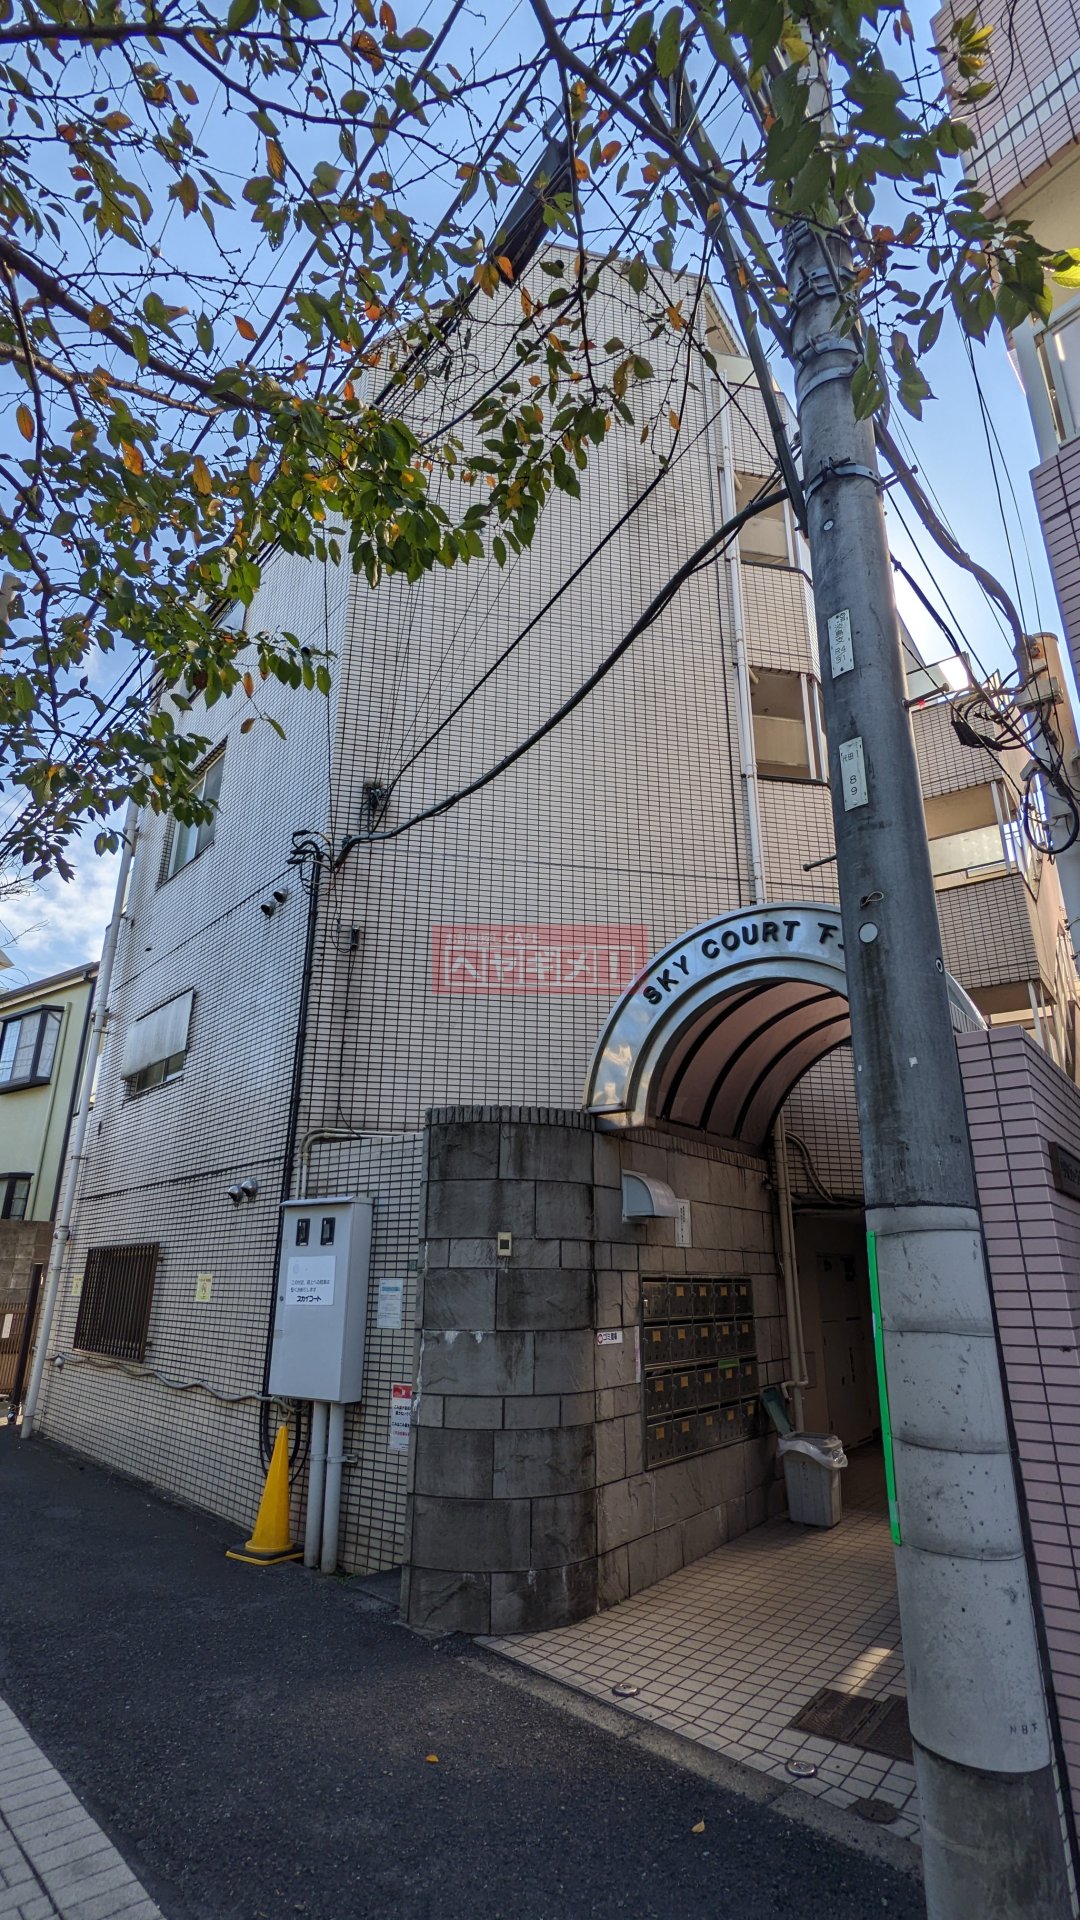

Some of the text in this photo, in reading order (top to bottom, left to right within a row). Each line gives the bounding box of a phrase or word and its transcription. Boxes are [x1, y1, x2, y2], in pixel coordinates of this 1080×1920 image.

[643, 920, 844, 1005] SKY COURT F
[296, 1295, 322, 1303] スカイコート
